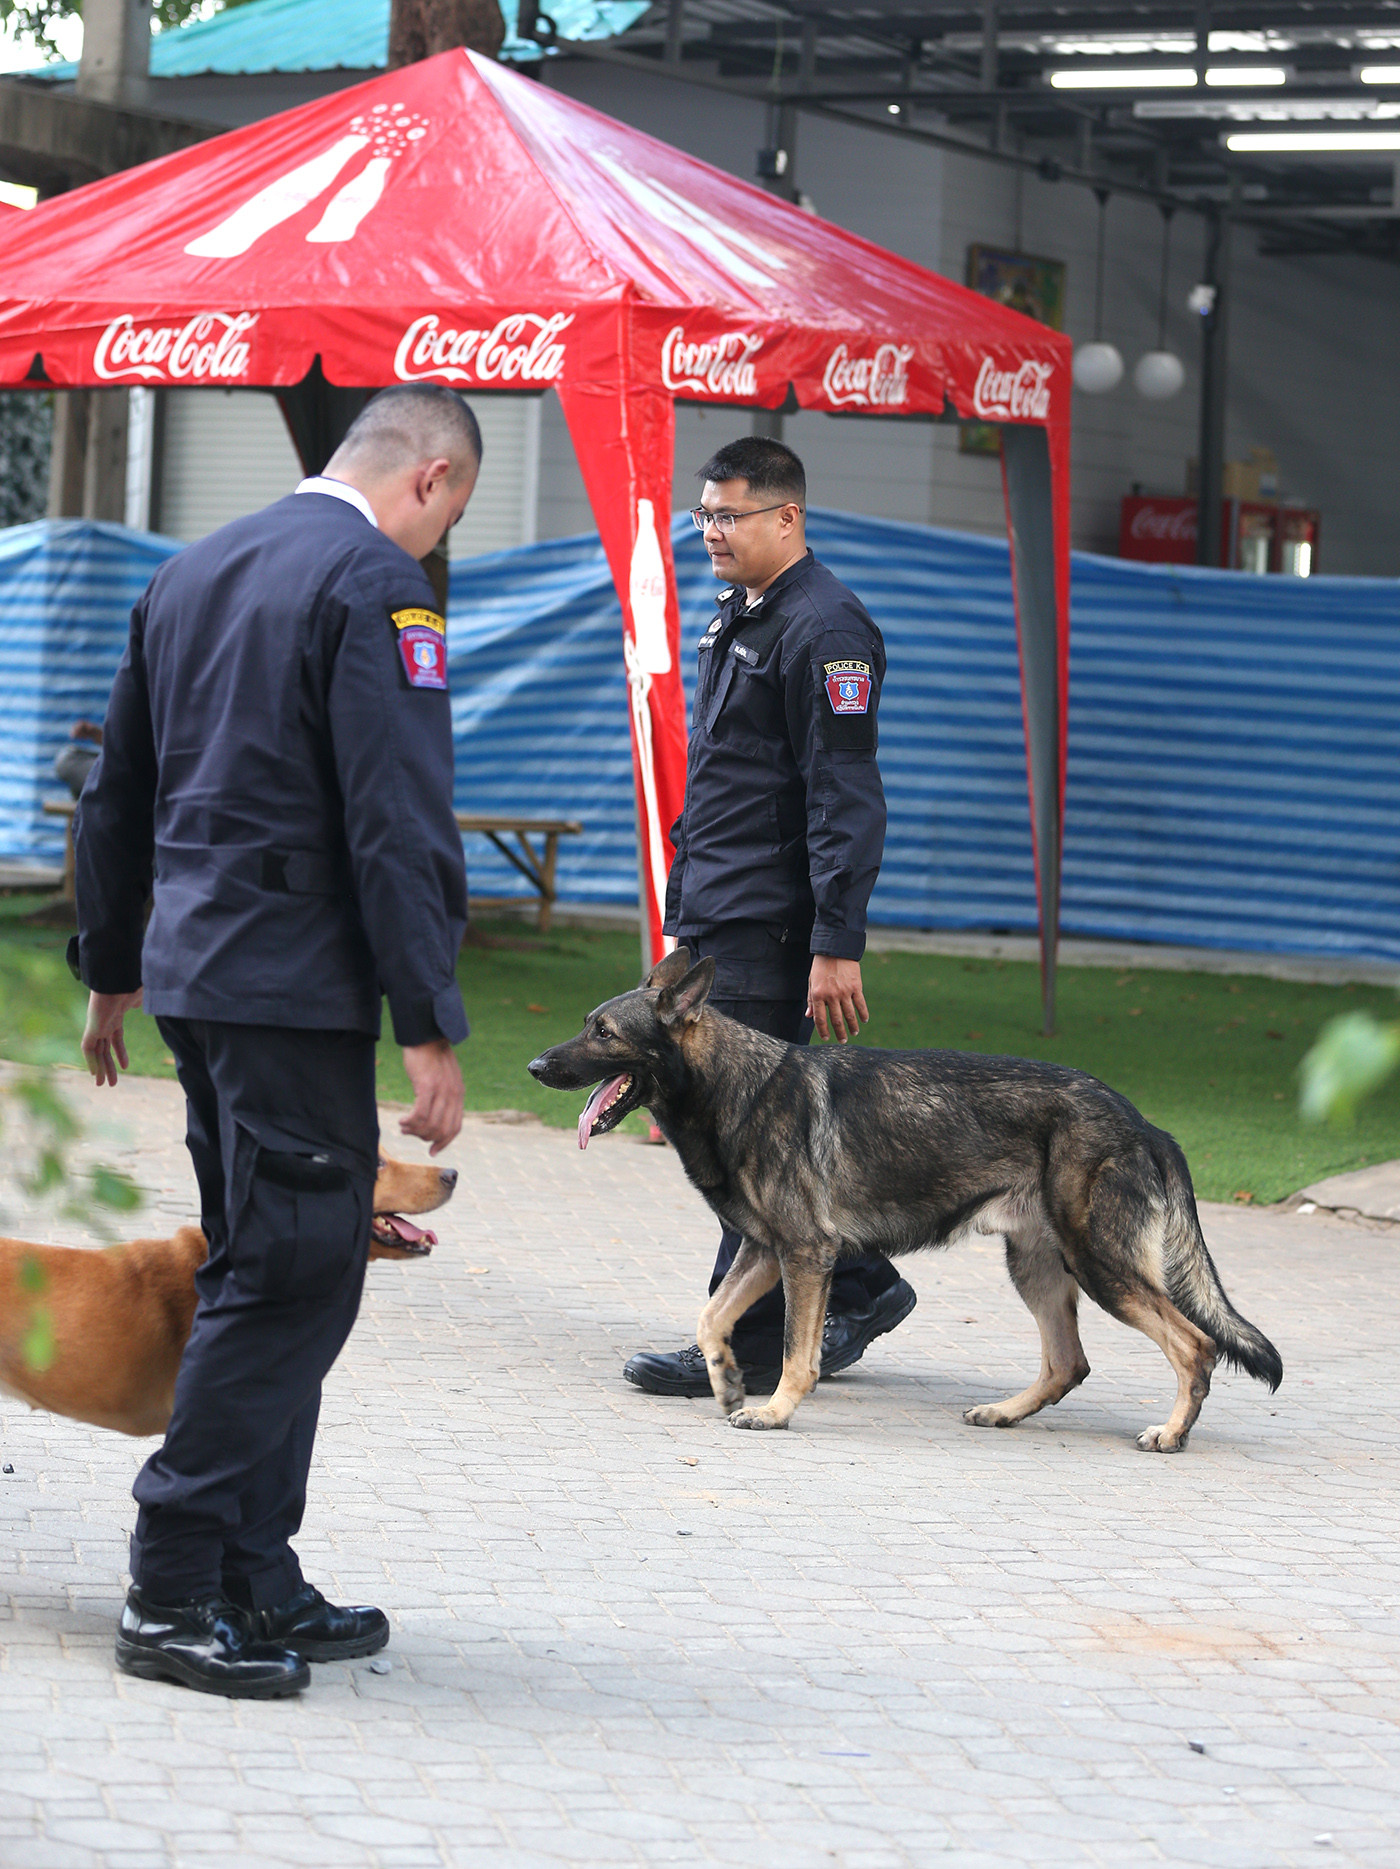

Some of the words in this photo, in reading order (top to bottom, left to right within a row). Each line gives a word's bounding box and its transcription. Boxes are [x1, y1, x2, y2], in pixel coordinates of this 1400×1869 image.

[93, 311, 261, 380] Coca-Cola
[394, 311, 576, 382] Coca-Cola
[661, 326, 765, 396] Coca-Cola
[822, 343, 915, 405] Coca-Cola
[973, 356, 1054, 418] Coca-Cola
[827, 662, 853, 672] POLICE
